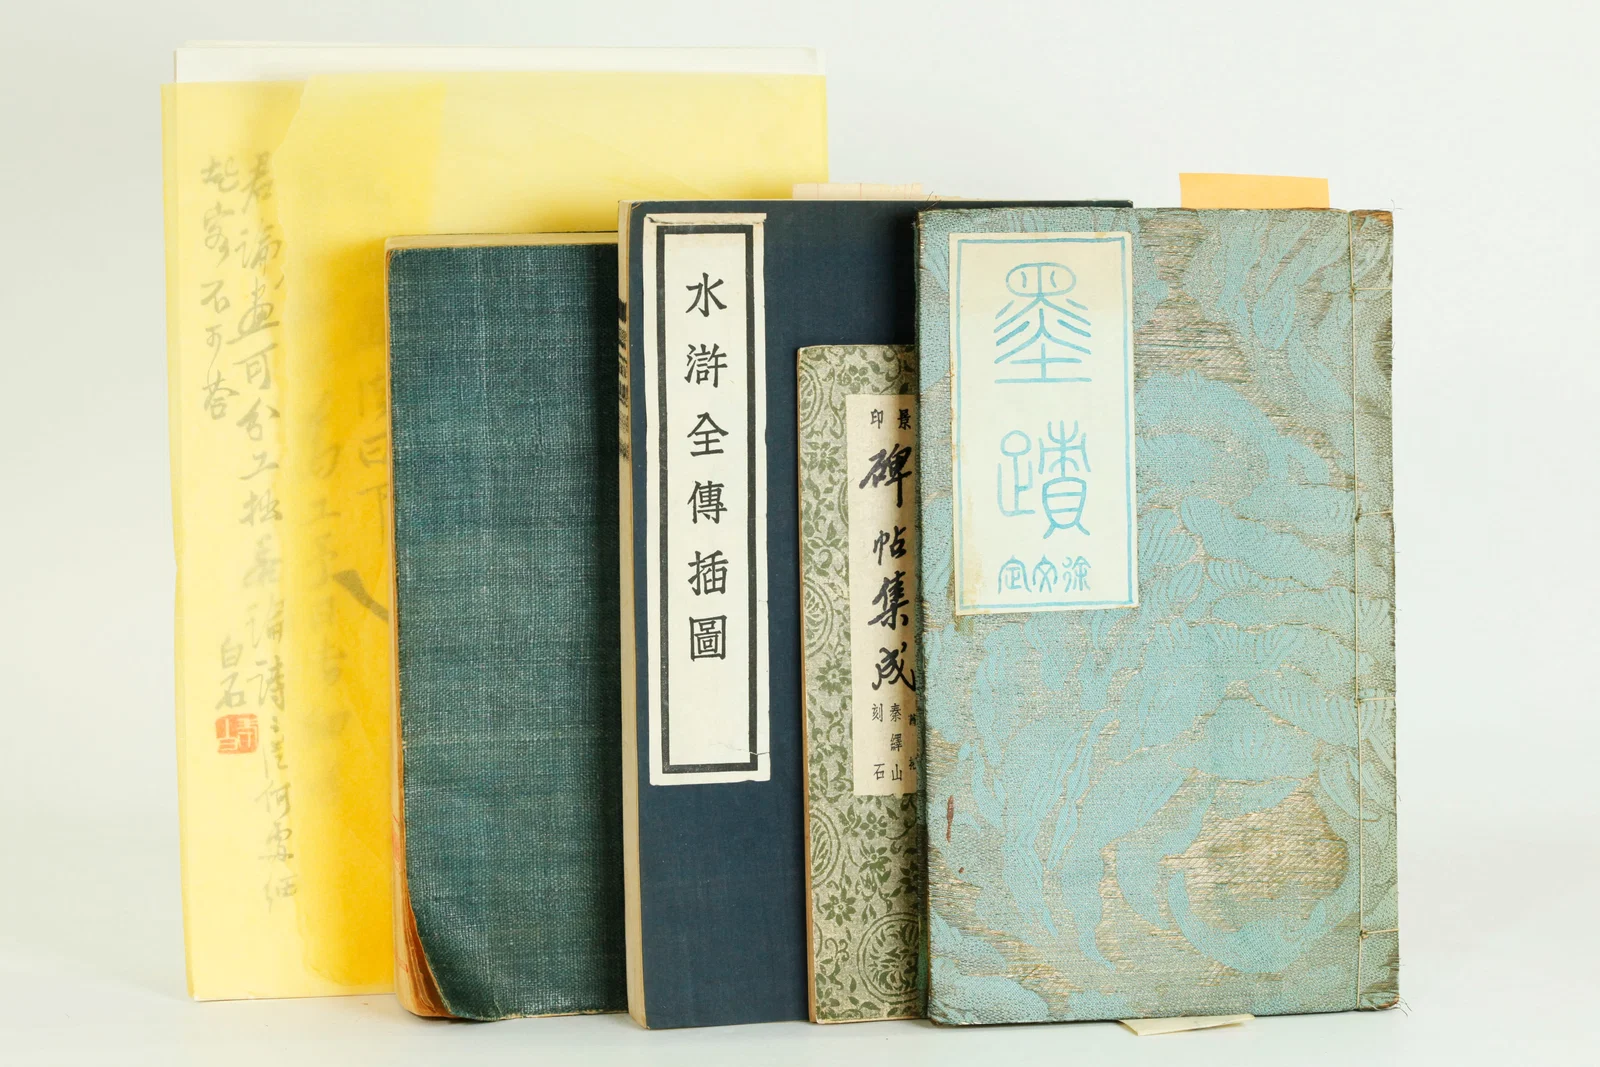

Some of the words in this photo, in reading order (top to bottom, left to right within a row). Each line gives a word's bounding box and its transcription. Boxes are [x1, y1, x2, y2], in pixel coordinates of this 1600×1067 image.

[684, 272, 728, 662] 水滸全傳插圖
[859, 443, 917, 691] 碑帖集成
